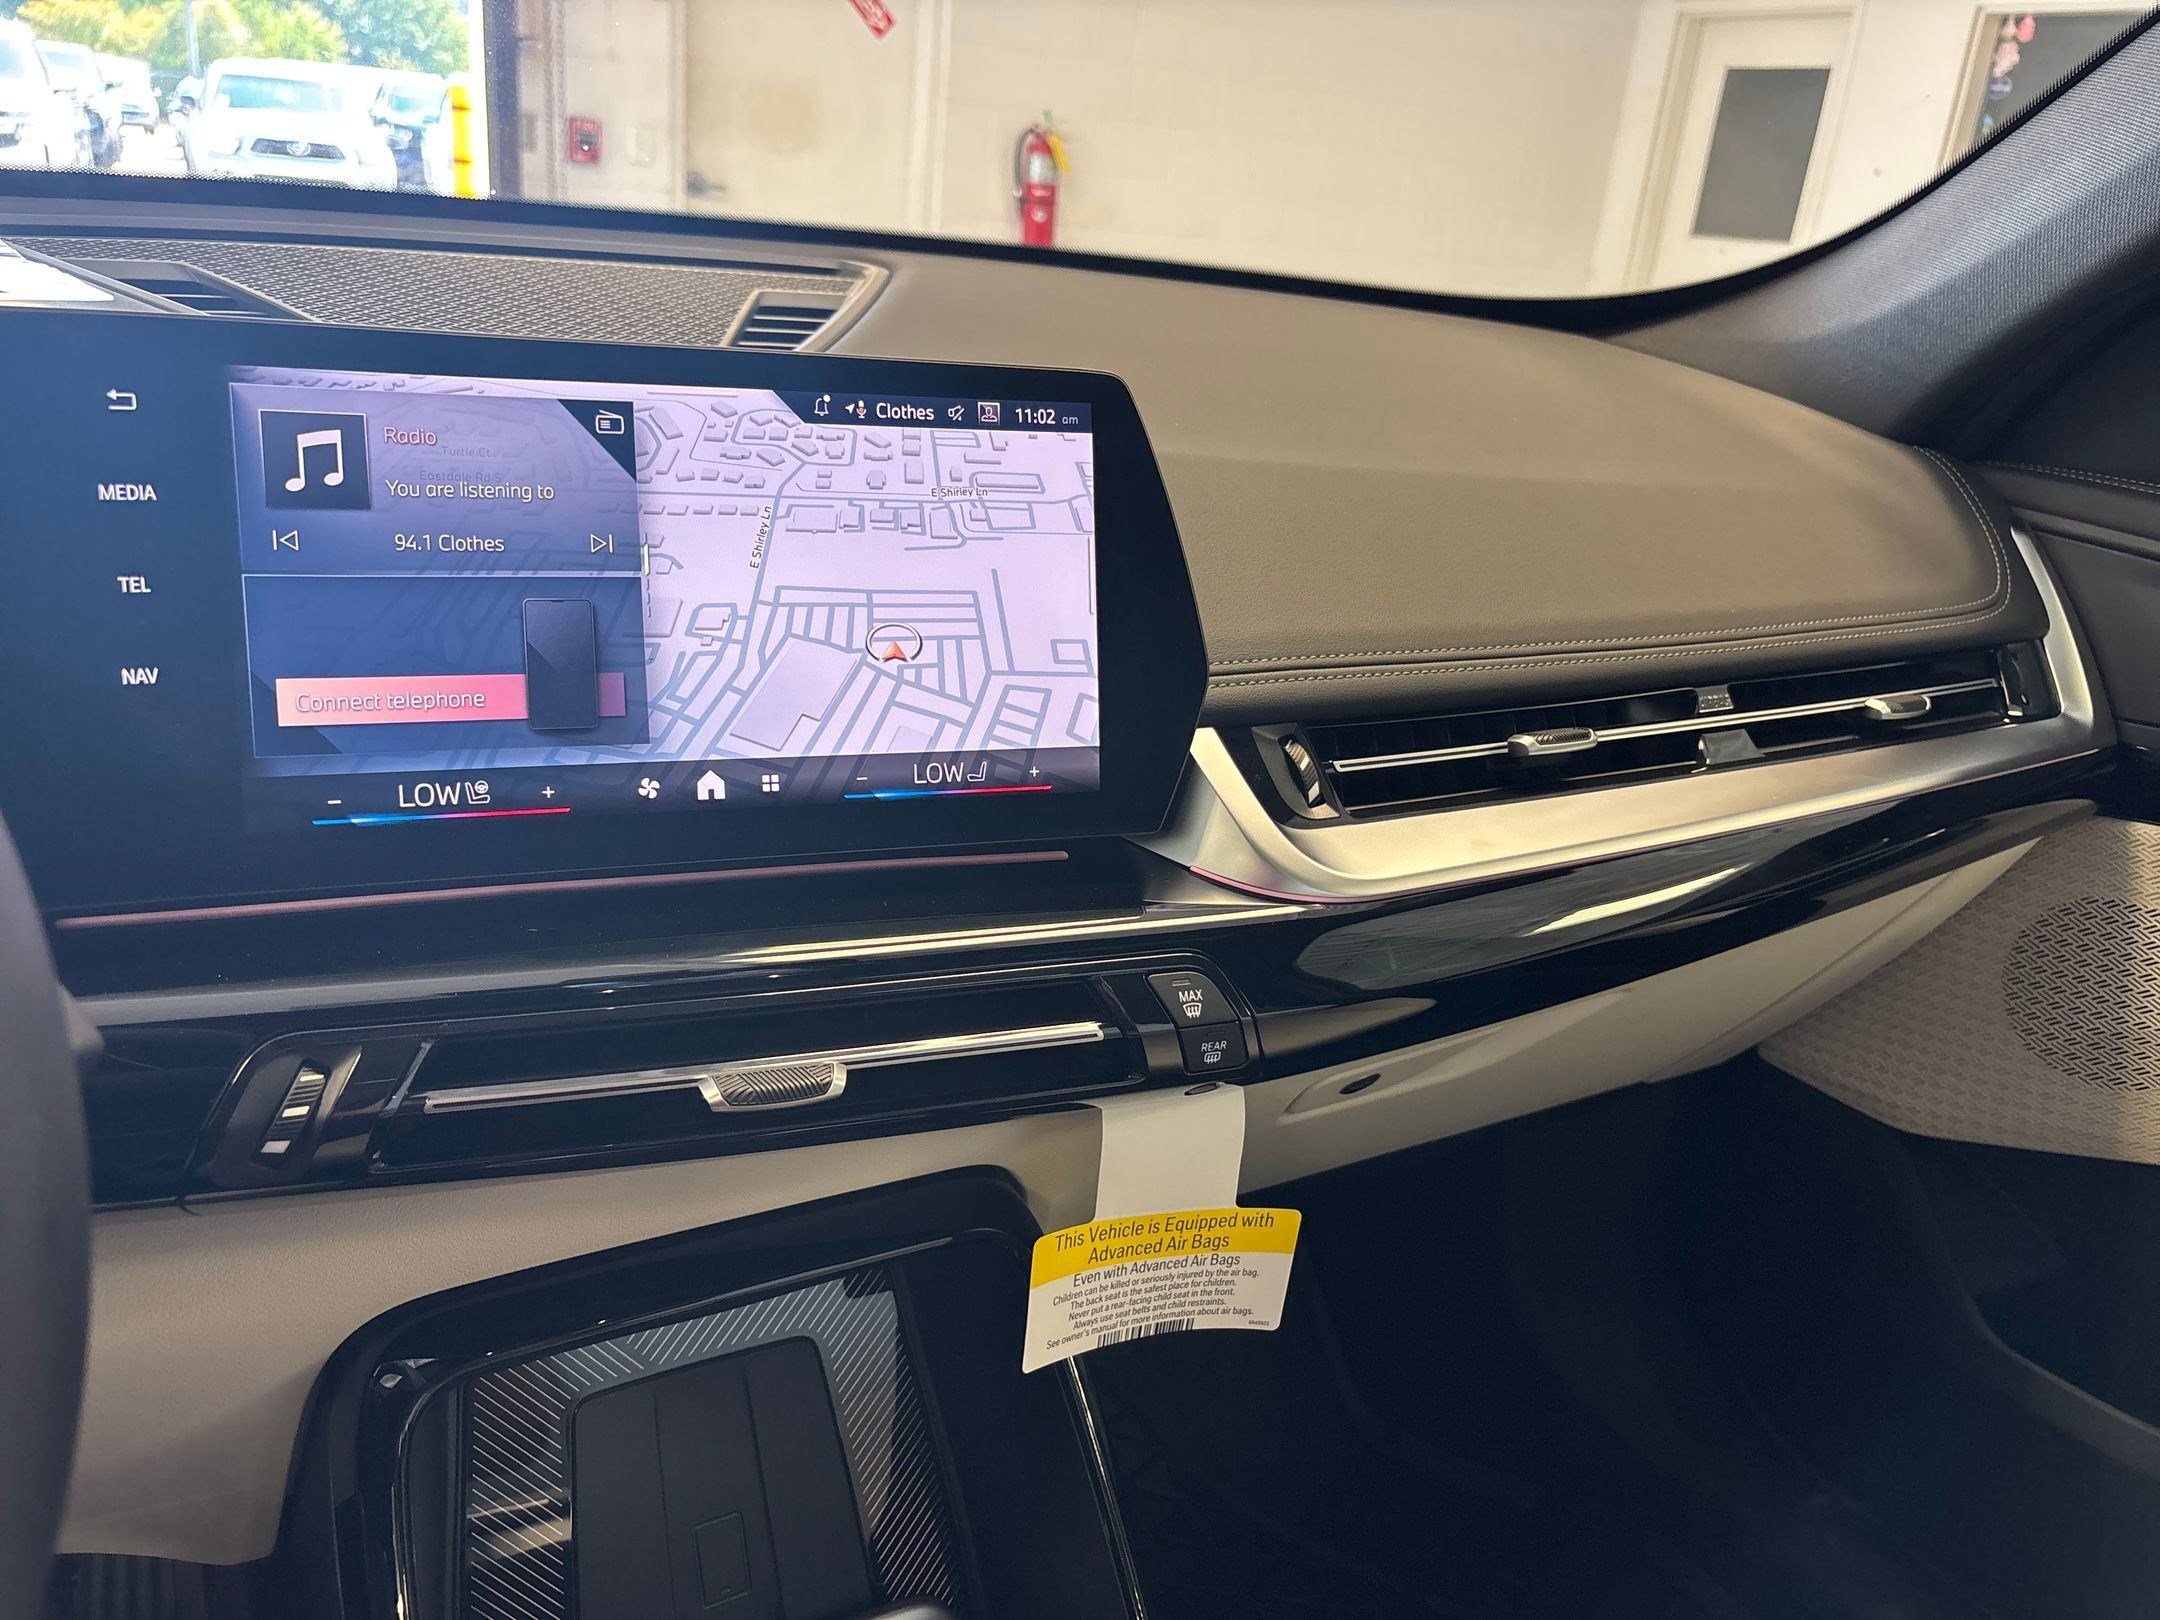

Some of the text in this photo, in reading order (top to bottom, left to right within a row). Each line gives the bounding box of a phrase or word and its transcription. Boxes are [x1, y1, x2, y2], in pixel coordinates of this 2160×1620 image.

[876, 402, 1078, 424] Clothes 11:02 am
[384, 427, 437, 444] Radio
[476, 472, 490, 482] Rd
[98, 484, 157, 501] MEDIA
[385, 480, 554, 502] You are listening to
[931, 487, 988, 498] E Shirley Ln
[760, 506, 772, 520] Ln
[394, 534, 504, 552] 94.1 Clothes
[752, 522, 769, 558] Shirley
[117, 576, 151, 594] TEL
[121, 667, 158, 686] NAV
[296, 691, 486, 712] Connect telephone
[913, 762, 965, 784] LOW
[398, 782, 460, 808] LOW
[1178, 989, 1203, 1002] MAX
[1201, 1040, 1226, 1052] REAR
[1056, 1212, 1274, 1252] This Vehicle is Equipped with
[1088, 1234, 1230, 1264] Advanced Air Bags
[1073, 1254, 1240, 1288] Even with Advanced Air Bags
[1053, 1290, 1083, 1306] Children
[1084, 1287, 1098, 1297] can
[1099, 1283, 1109, 1293] be
[1110, 1279, 1130, 1290] killed
[1141, 1272, 1175, 1284] seriously
[1176, 1270, 1203, 1280] injured
[1205, 1270, 1214, 1279] by
[1230, 1268, 1240, 1276] air
[1242, 1269, 1260, 1278] bag.
[1071, 1278, 1236, 1310] The back seat is the safest place for children.
[1069, 1310, 1090, 1321] Never
[1091, 1306, 1103, 1316] put
[1104, 1304, 1110, 1312] a
[1111, 1296, 1152, 1310] rear-facing
[1154, 1292, 1172, 1302] child
[1173, 1290, 1190, 1298] seat
[1200, 1288, 1212, 1296] the
[1214, 1288, 1235, 1296] front.
[1073, 1298, 1226, 1330] Always use seat belts and child restraints.
[1046, 1340, 1060, 1350] See
[1062, 1330, 1090, 1344] owner's
[1091, 1322, 1118, 1334] manual
[1120, 1319, 1130, 1328] for
[1131, 1316, 1150, 1324] more
[1152, 1310, 1195, 1320] information
[1197, 1308, 1219, 1316] about
[1233, 1308, 1254, 1316] bags.
